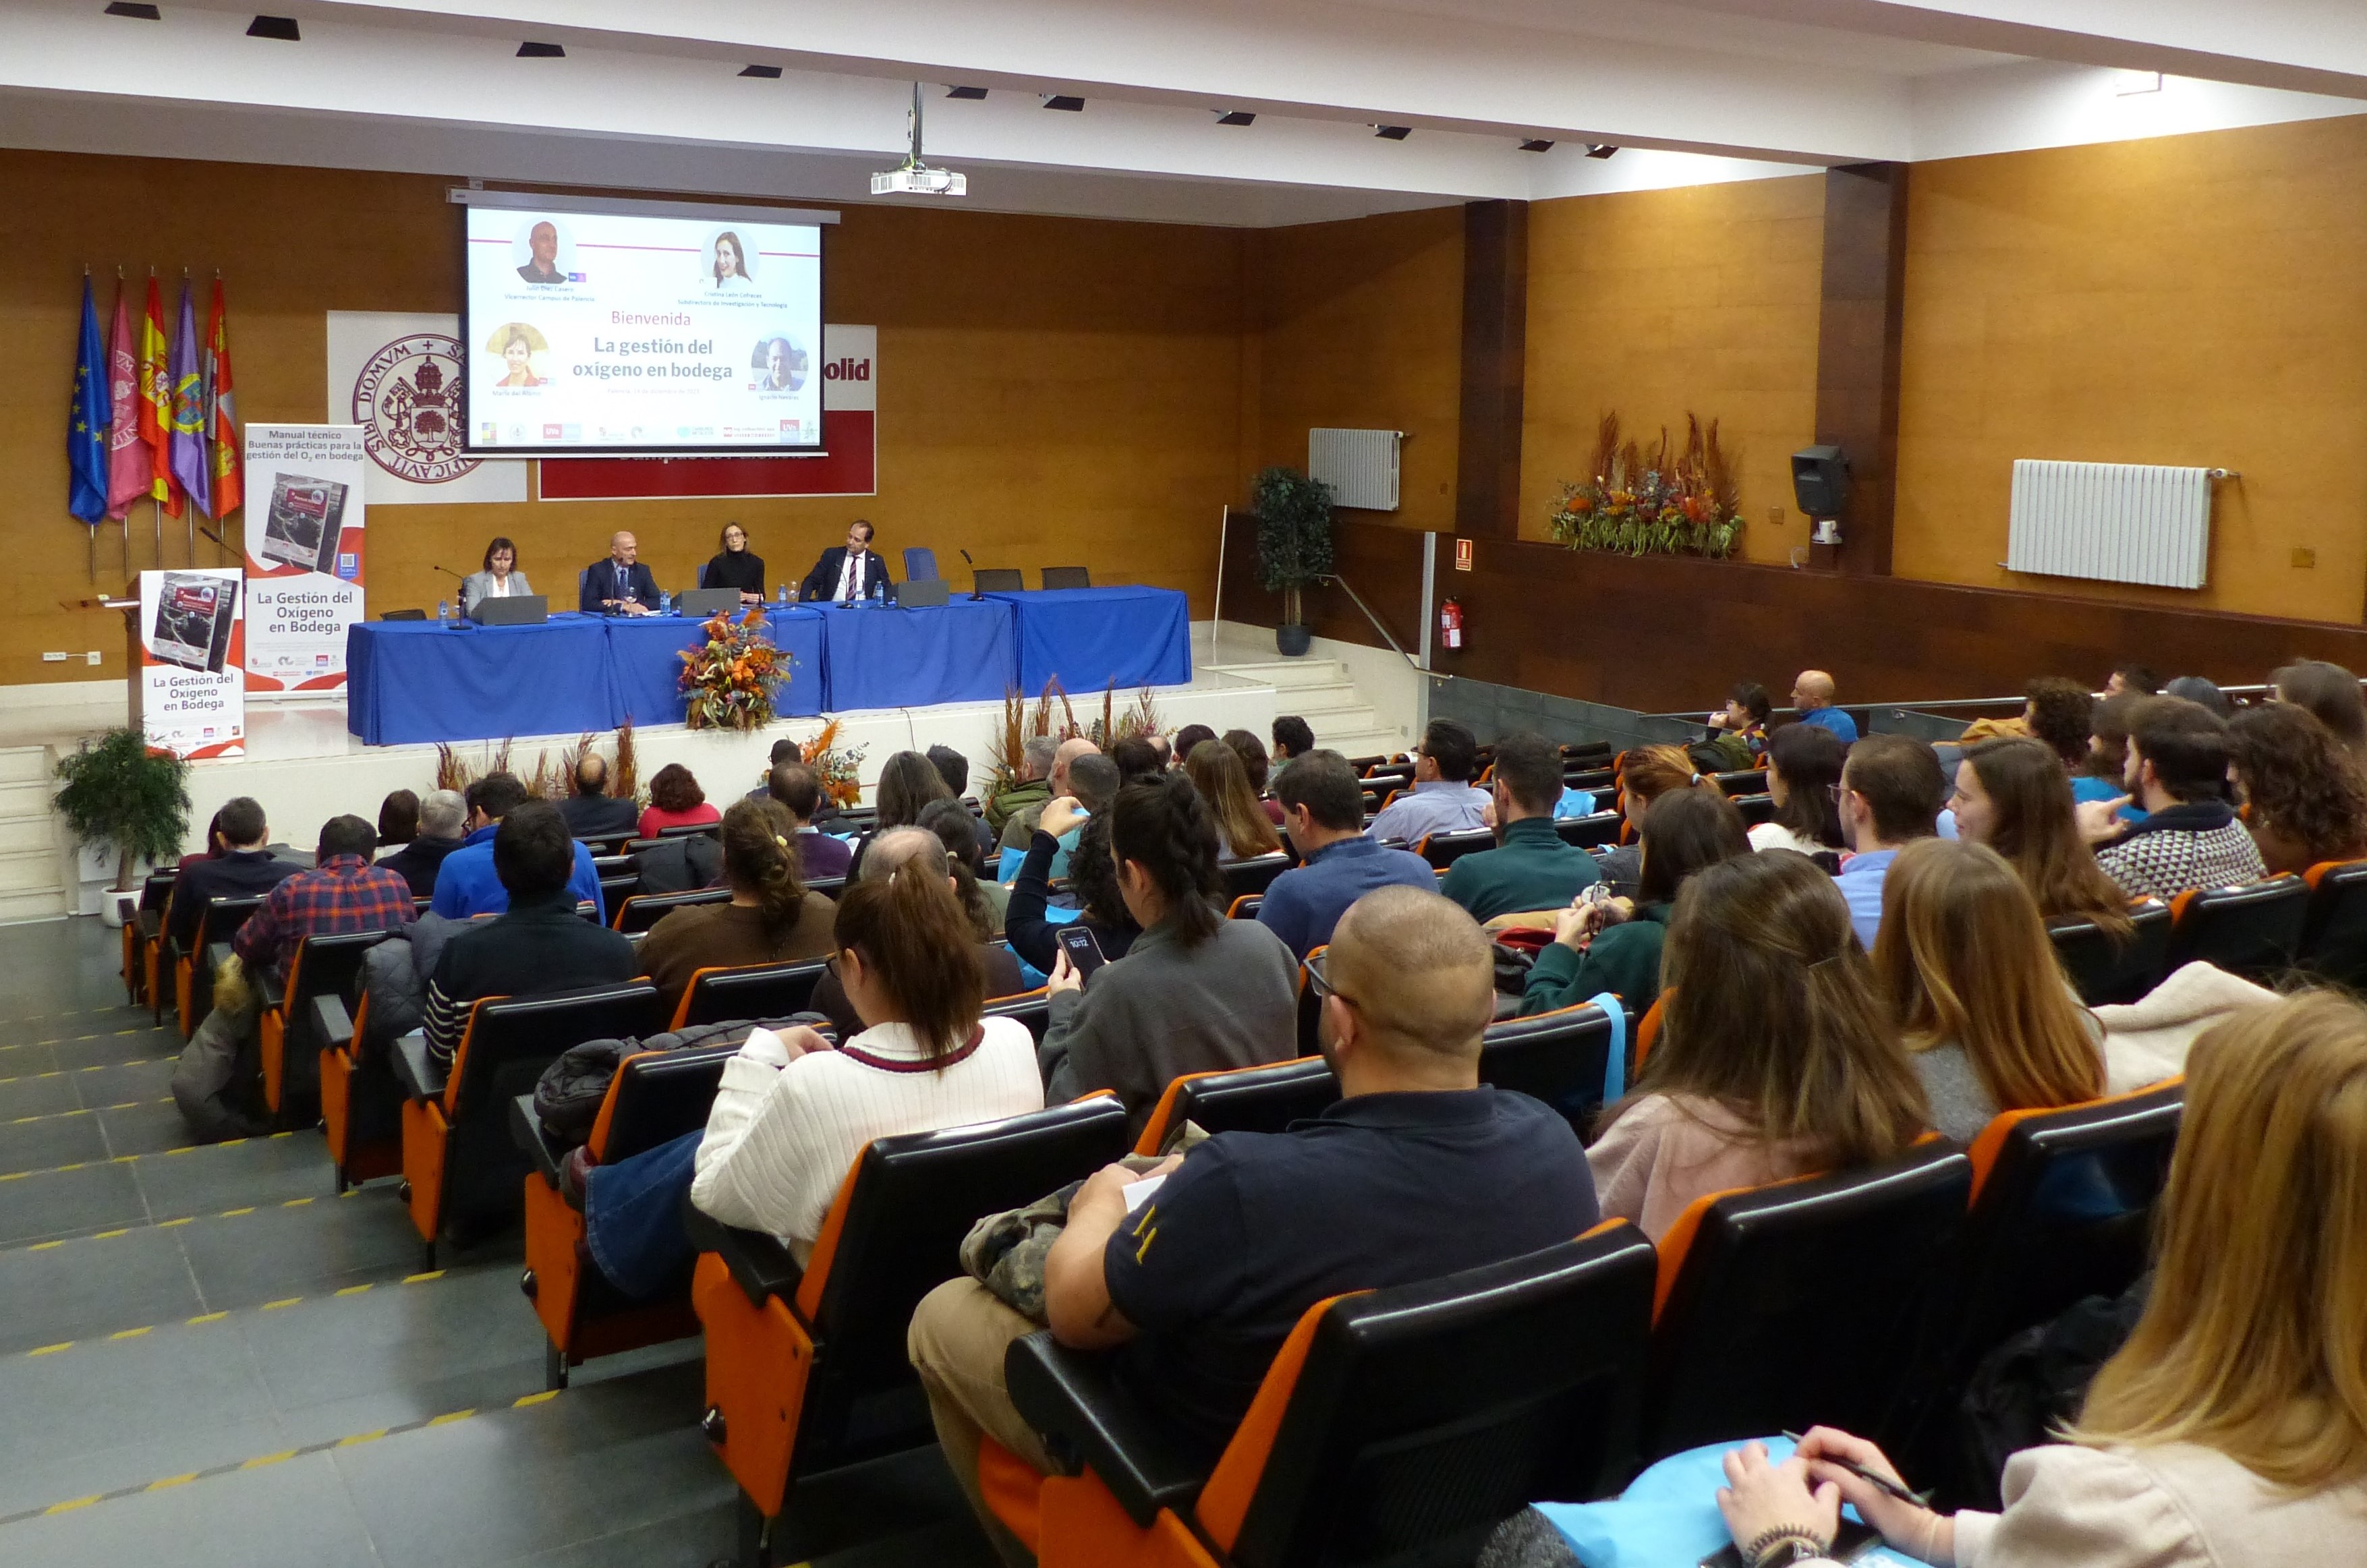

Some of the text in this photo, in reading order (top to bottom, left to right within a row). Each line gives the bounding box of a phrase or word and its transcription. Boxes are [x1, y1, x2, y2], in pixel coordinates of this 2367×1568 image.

[611, 311, 691, 326] Bienvenida
[594, 337, 713, 356] La gestión del
[573, 361, 733, 381] oxígeno en bodega
[824, 358, 870, 381] olid
[269, 431, 341, 439] Manual técnico
[248, 441, 283, 449] Buenas
[286, 441, 328, 451] prácticas
[353, 442, 362, 450] la
[246, 451, 281, 461] gestión
[283, 451, 298, 460] del
[329, 452, 364, 462] bodega
[258, 591, 353, 604] La Gestión del
[277, 606, 334, 621] Oxígeno
[269, 620, 341, 635] en Bodega
[154, 673, 233, 687] La Gestión del
[164, 699, 224, 711] en Bodega
[1069, 939, 1089, 948] 10:12
